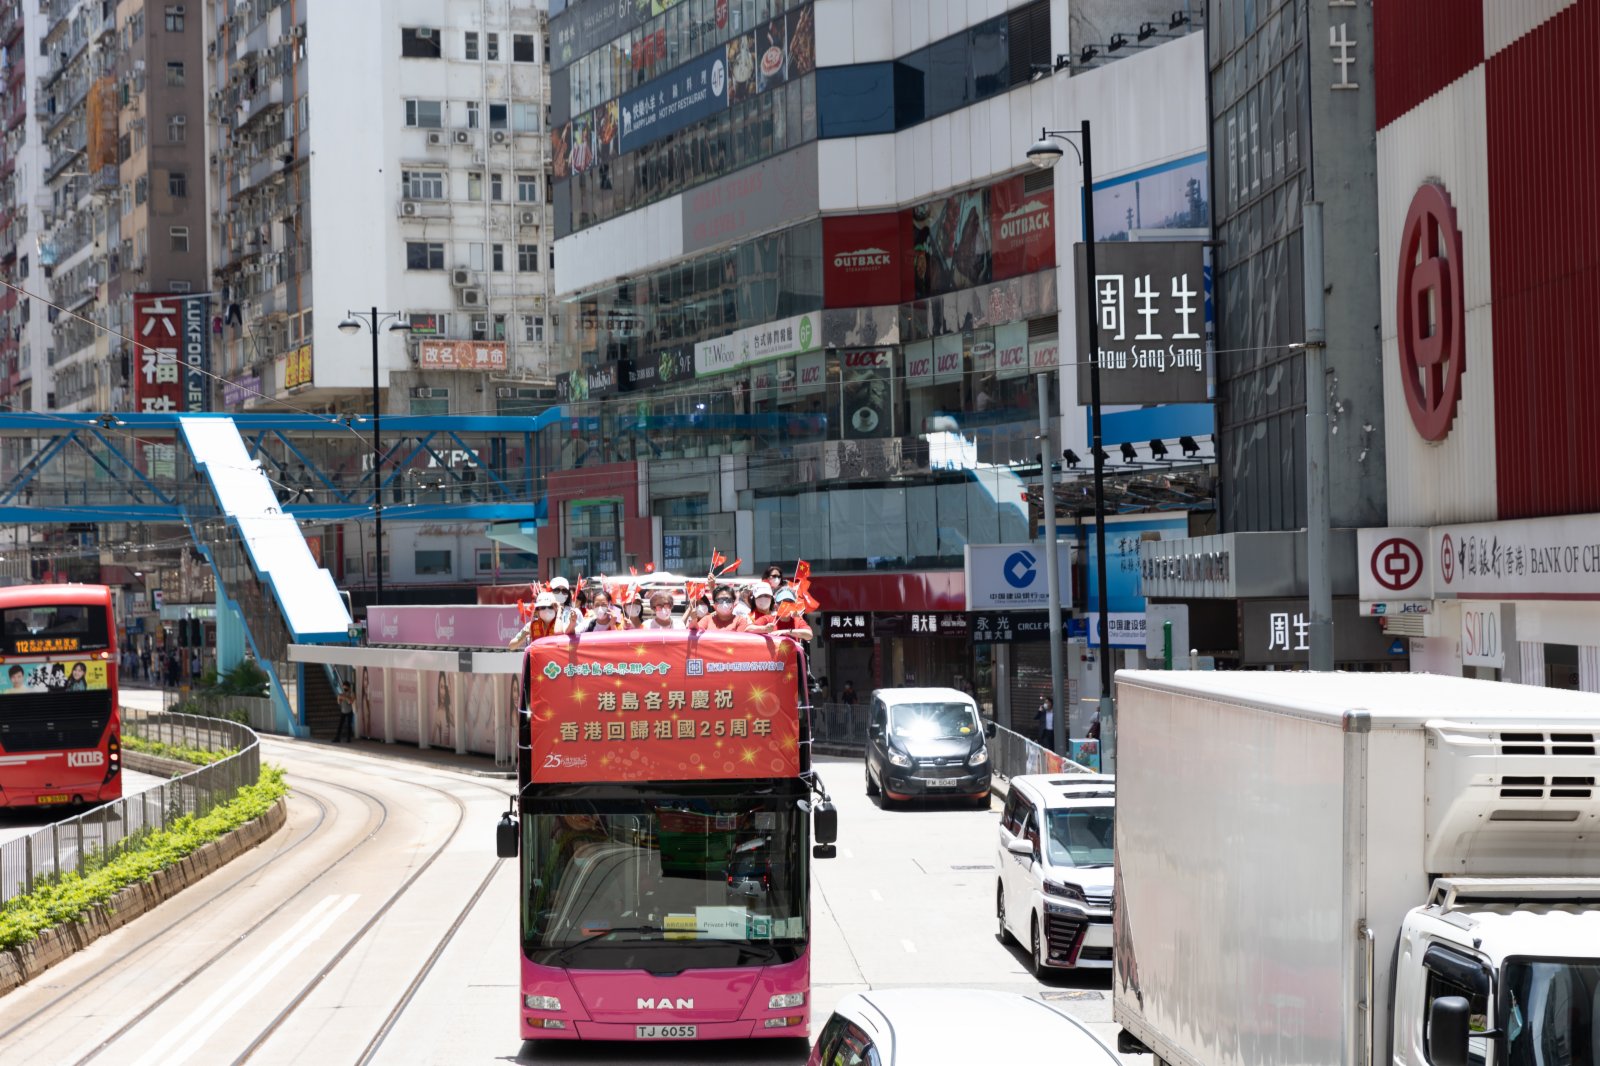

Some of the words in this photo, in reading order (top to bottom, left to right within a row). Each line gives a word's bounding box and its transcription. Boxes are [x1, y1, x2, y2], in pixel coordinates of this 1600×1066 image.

[1001, 211, 1050, 240] OUTBACK
[834, 255, 891, 268] OUTBACK
[1095, 273, 1200, 340] 周生生
[186, 300, 202, 377] LUKFOOK
[845, 351, 887, 367] UCC
[937, 353, 959, 372] UCC
[1000, 347, 1024, 367] UCC
[1034, 347, 1058, 367] UCC
[1089, 345, 1126, 369] how
[1131, 344, 1165, 373] Sang
[1169, 344, 1202, 372] Sang
[802, 366, 820, 384] UCC
[909, 358, 930, 376] UCC
[427, 449, 480, 468] KFC
[1530, 546, 1562, 573] BANK
[1564, 545, 1580, 573] OF
[830, 616, 865, 628] 周大福
[911, 614, 938, 632] 周大福
[977, 616, 1010, 631] 永光
[1017, 622, 1041, 631] CIRCLE
[1465, 611, 1497, 657] SOLO
[16, 640, 29, 653] 112
[597, 689, 734, 711] 港島各界慶祝
[559, 717, 772, 742] 香港回歸祖國25周年
[67, 751, 104, 767] KMB
[543, 754, 561, 768] 25
[725, 920, 739, 928] Hire
[636, 997, 694, 1010] MAN
[638, 1025, 656, 1038] TJ
[661, 1025, 695, 1038] 6055
